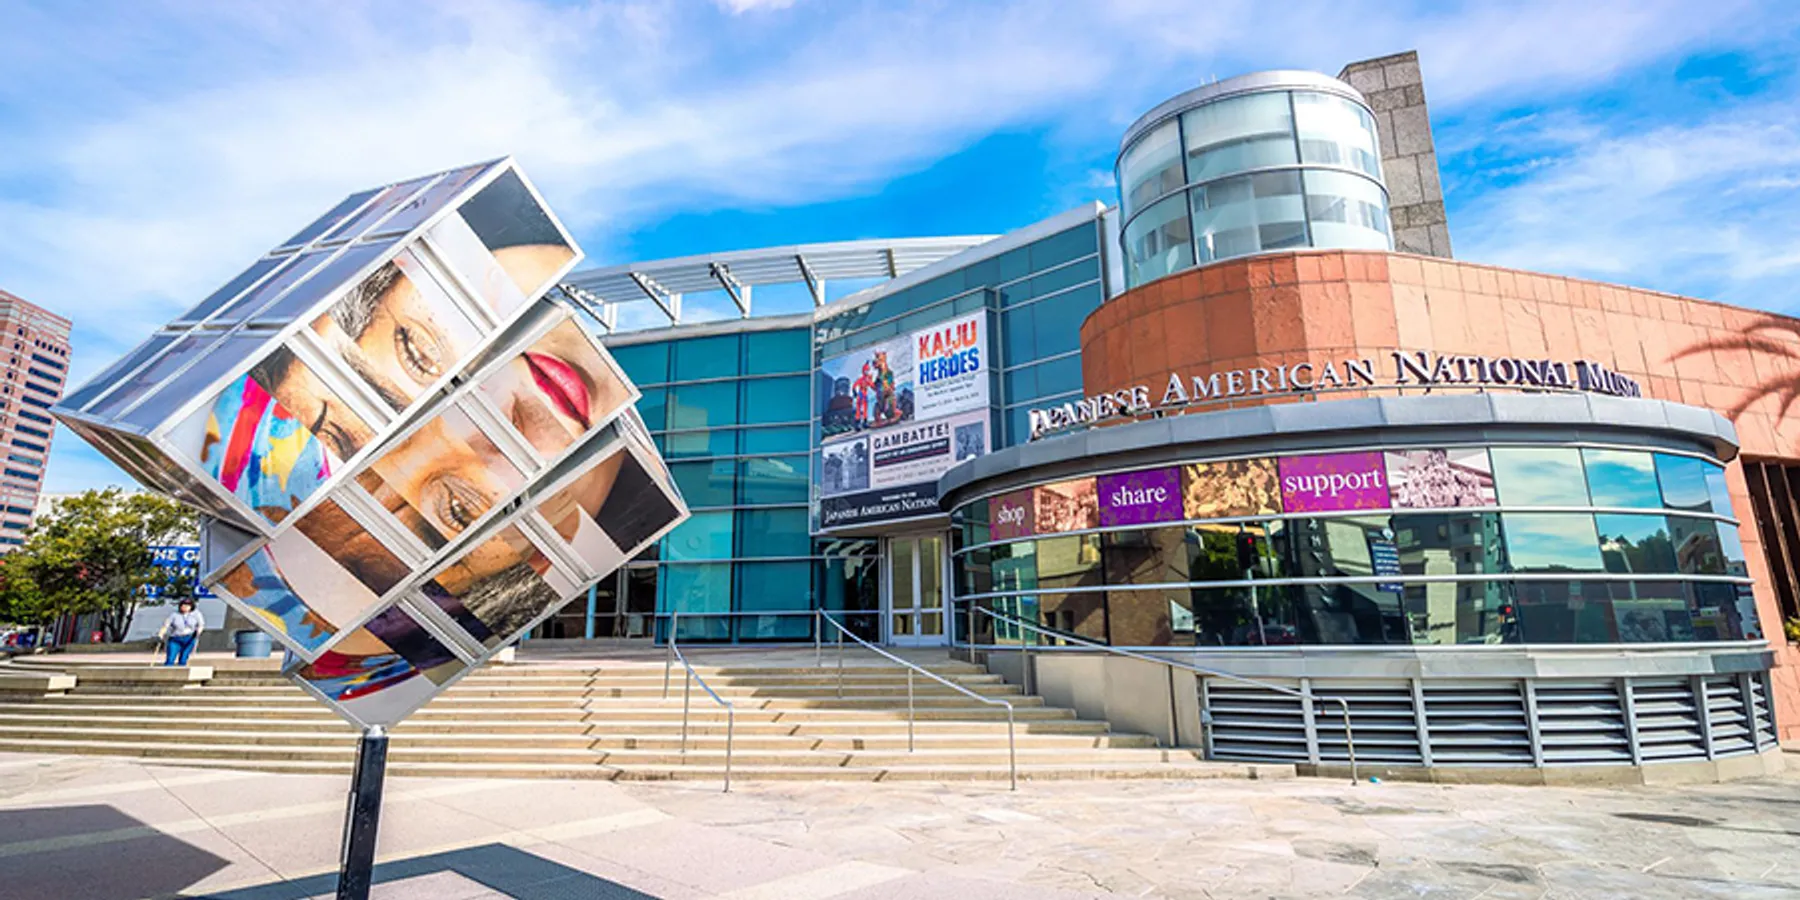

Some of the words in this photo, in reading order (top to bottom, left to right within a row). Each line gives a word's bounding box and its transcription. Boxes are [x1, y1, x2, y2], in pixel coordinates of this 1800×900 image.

[919, 320, 977, 360] KAIJU
[919, 347, 980, 385] HEROES
[1026, 385, 1151, 443] JAPANESE
[1160, 359, 1376, 404] AMERICAN
[1391, 349, 1577, 388] NATIONAL
[874, 422, 950, 450] GAMBATTE!
[1111, 484, 1168, 507] share
[1284, 467, 1384, 496] support
[901, 497, 939, 511] NATION
[997, 504, 1026, 526] shop
